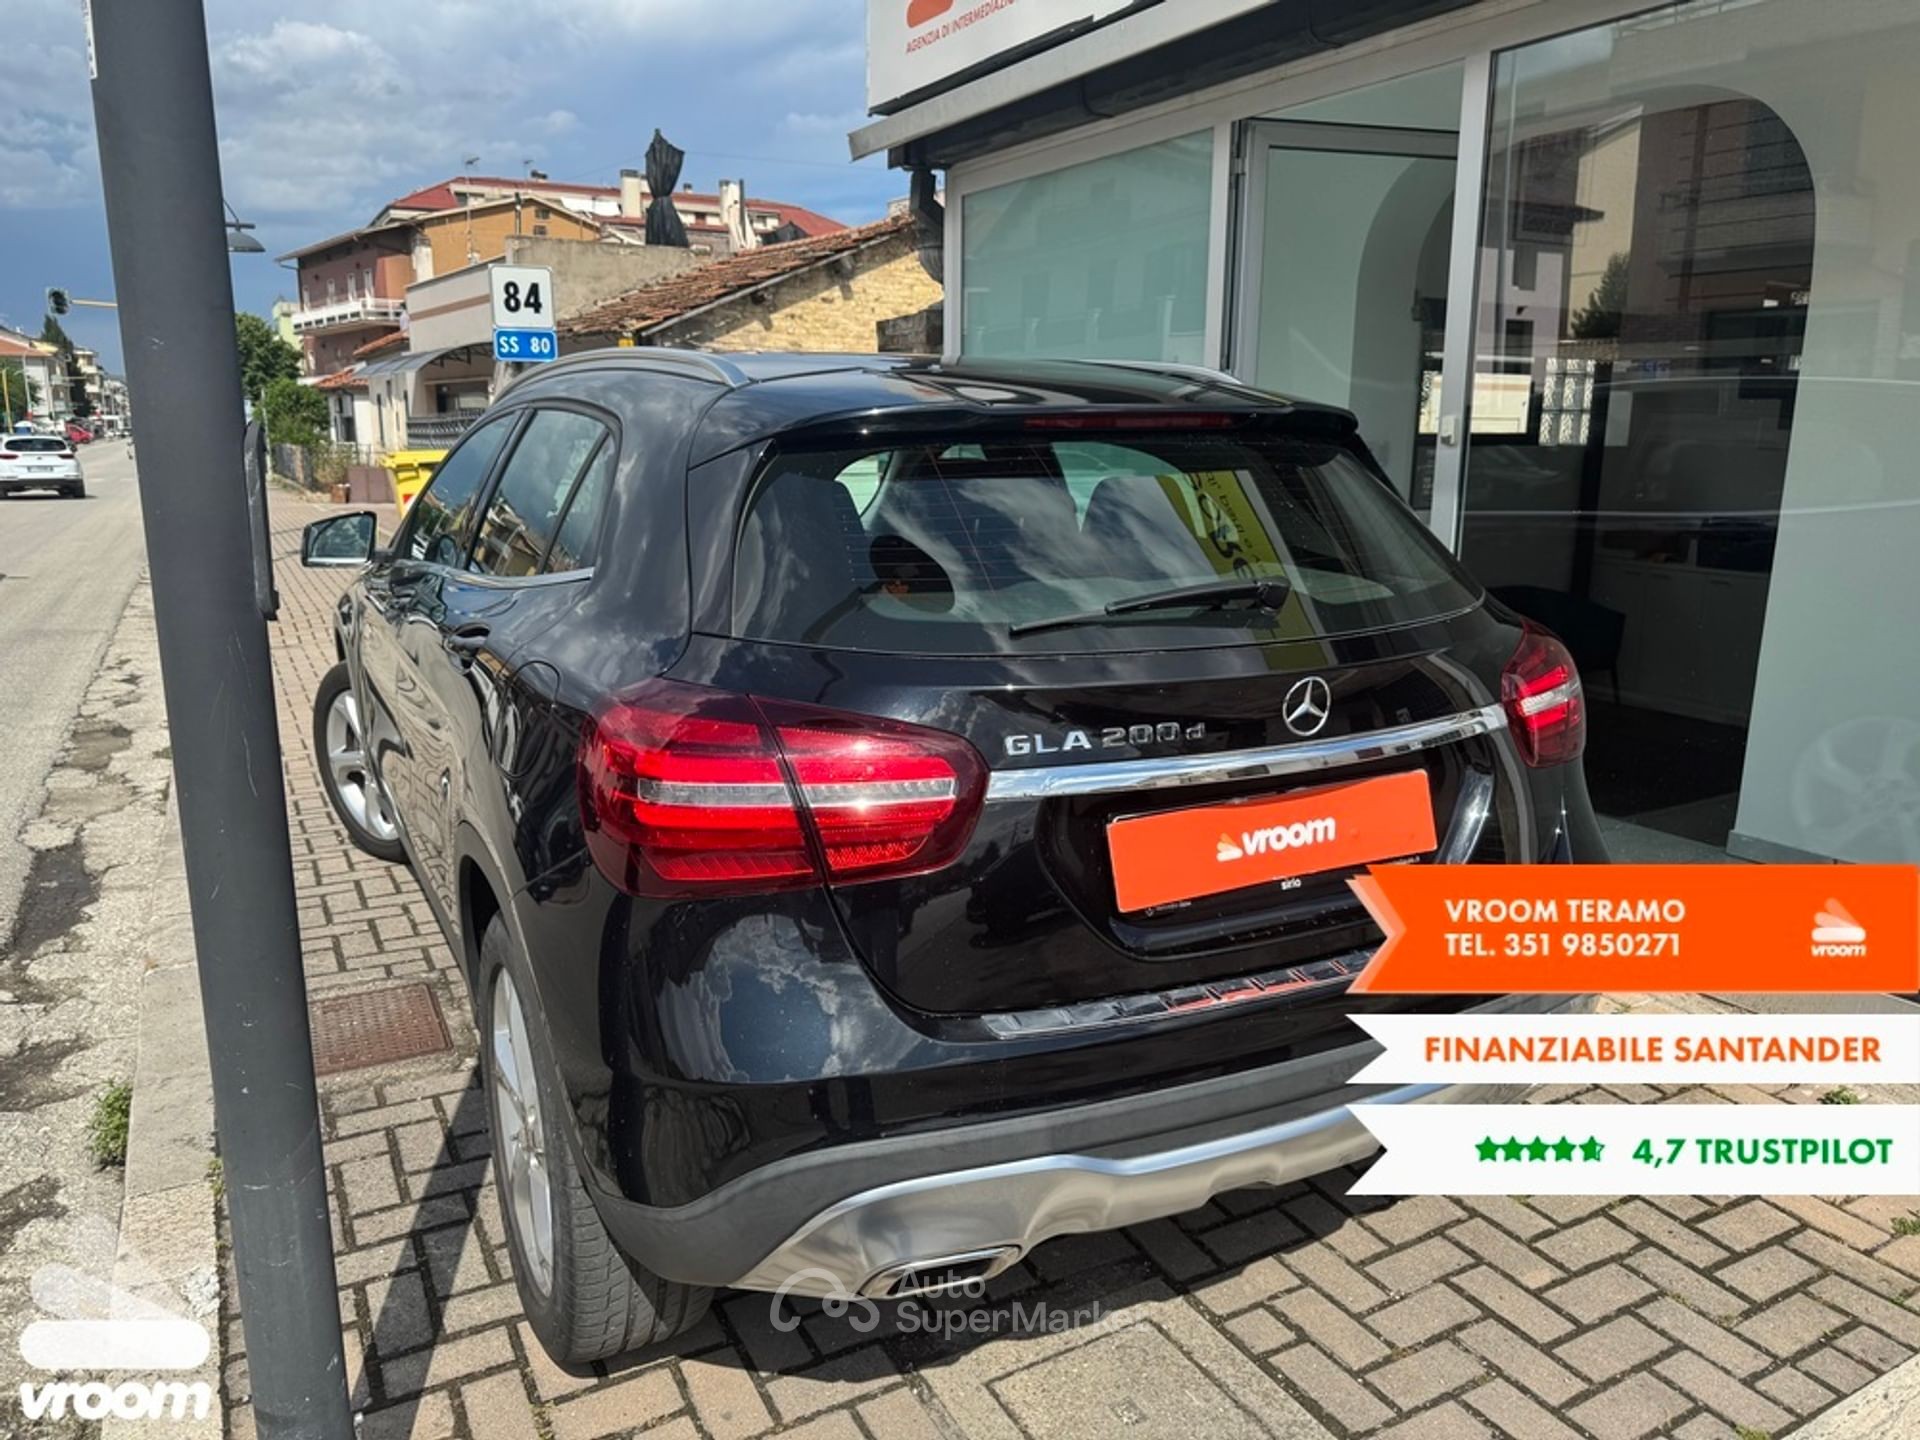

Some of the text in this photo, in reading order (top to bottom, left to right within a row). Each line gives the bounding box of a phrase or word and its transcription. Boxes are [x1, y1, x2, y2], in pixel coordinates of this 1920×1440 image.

[503, 281, 543, 314] 84
[499, 335, 551, 354] SS 80
[1004, 730, 1093, 757] GLA
[1241, 816, 1336, 856] vroom
